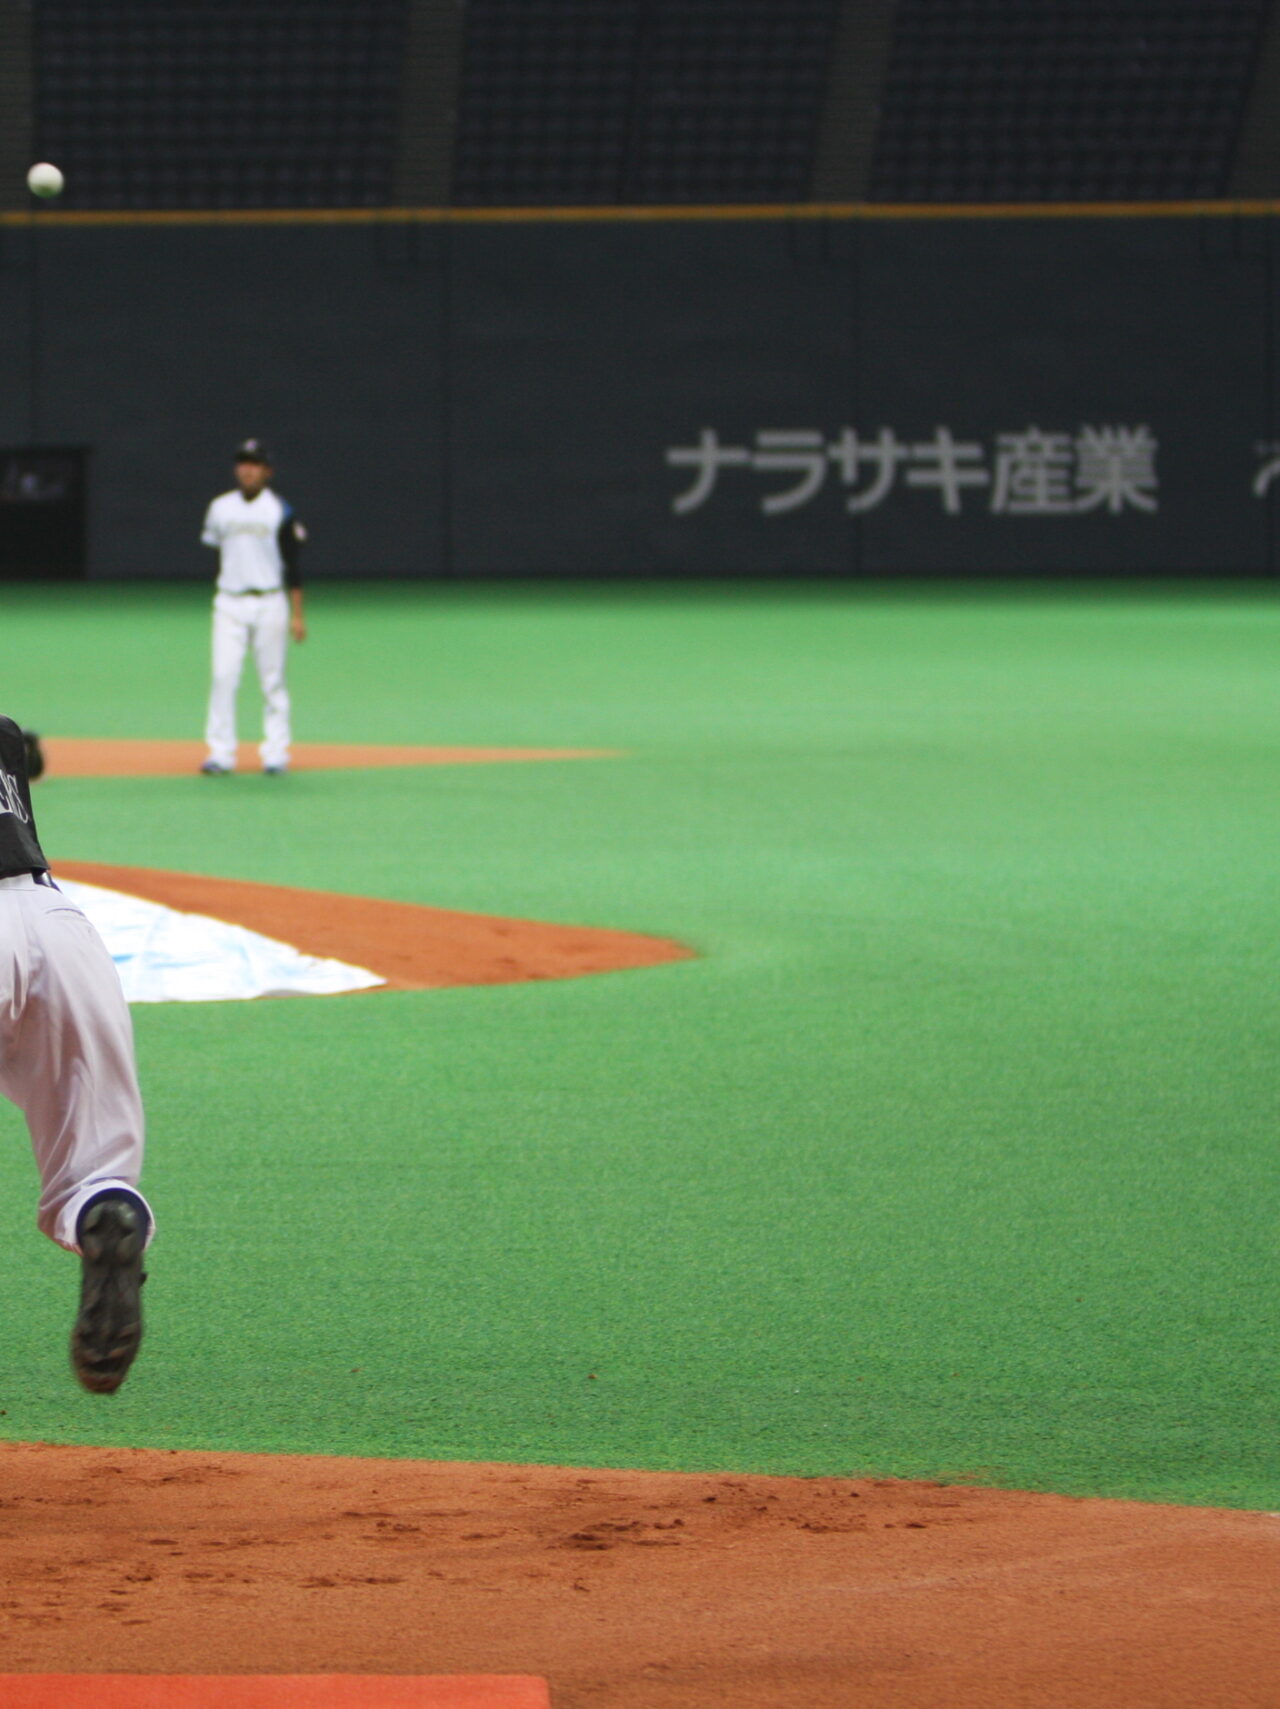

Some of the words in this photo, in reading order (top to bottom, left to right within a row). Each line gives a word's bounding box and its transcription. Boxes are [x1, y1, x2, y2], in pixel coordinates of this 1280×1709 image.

[665, 425, 1160, 514] ナラサキ産業
